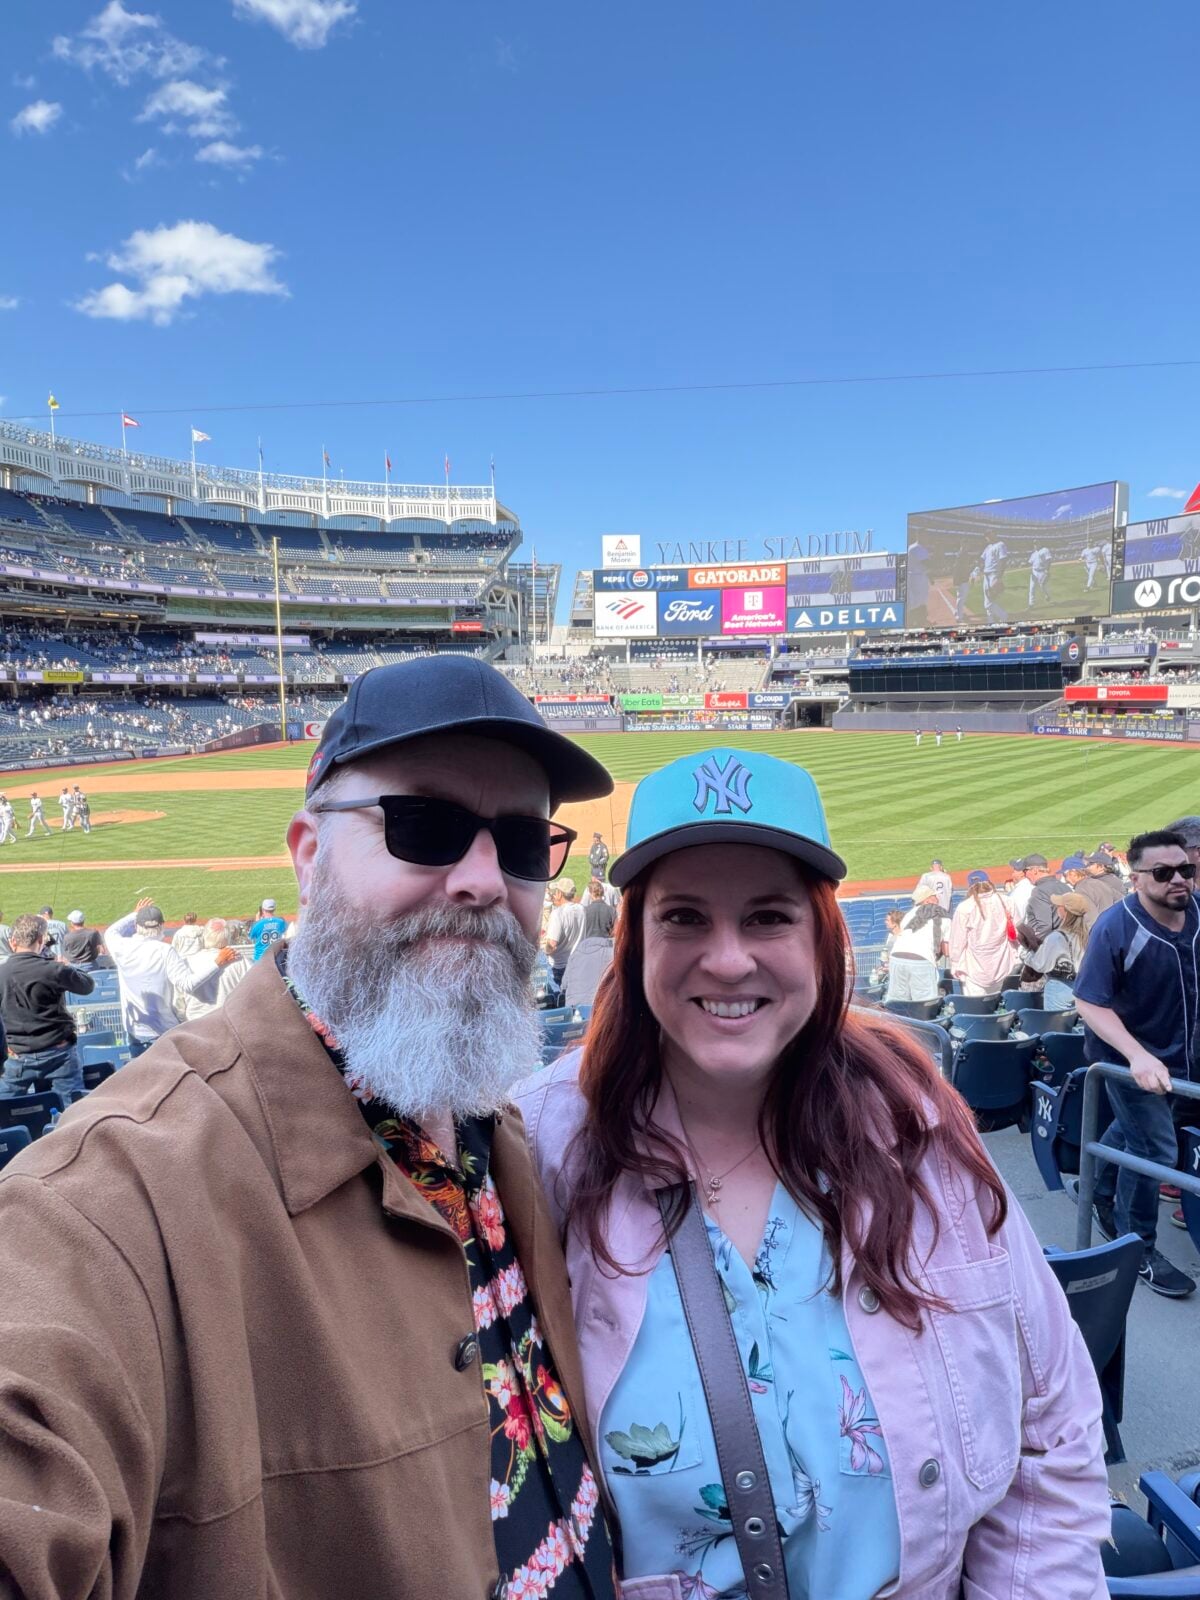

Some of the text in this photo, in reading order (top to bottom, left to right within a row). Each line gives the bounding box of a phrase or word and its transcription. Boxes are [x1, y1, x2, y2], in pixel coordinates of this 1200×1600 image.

[1146, 520, 1168, 536] WIN
[656, 529, 875, 565] YANKEE STADIUM
[803, 558, 862, 573] WIN WIN
[1132, 564, 1154, 579] WIN
[693, 567, 781, 584] GATORADE
[793, 590, 894, 607] WIN WIN WIN
[664, 600, 715, 622] Ford
[731, 613, 776, 621] America's
[820, 607, 897, 625] DELTA
[745, 619, 783, 627] Network
[641, 698, 660, 706] Eats
[763, 695, 783, 703] coupa
[584, 719, 597, 729] WIN
[692, 755, 753, 814] NY
[1038, 1095, 1053, 1122] NY
